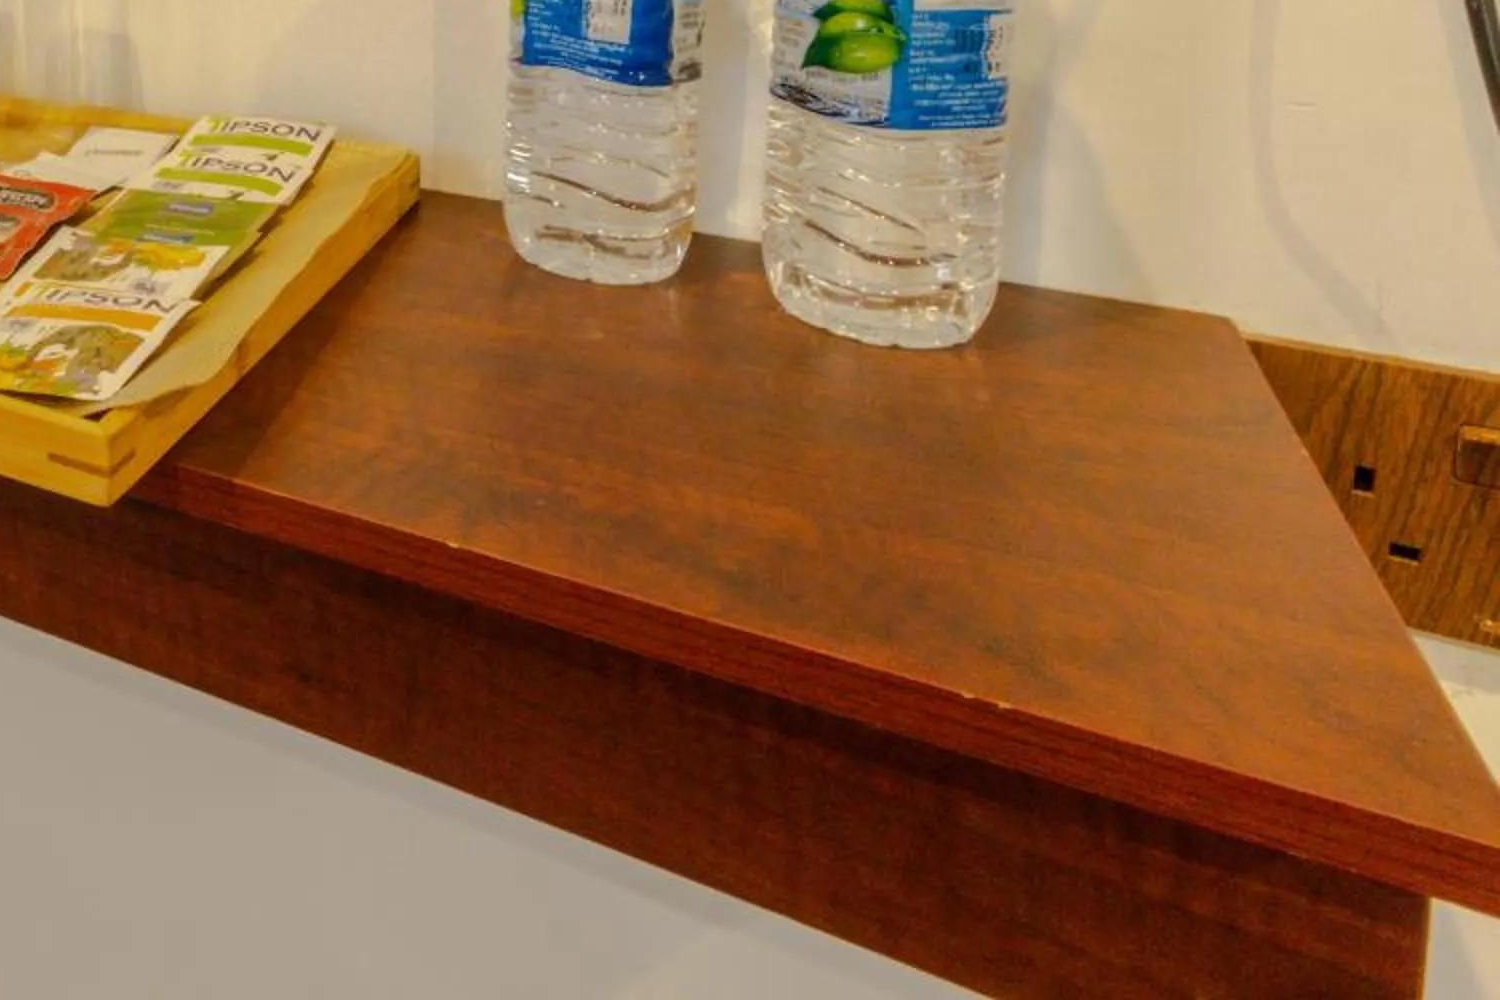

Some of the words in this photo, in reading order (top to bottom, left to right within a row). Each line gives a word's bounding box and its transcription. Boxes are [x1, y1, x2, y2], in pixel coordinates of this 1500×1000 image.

[208, 119, 321, 142] TIPSON
[180, 152, 296, 183] TIPSON
[35, 283, 178, 313] TIPSON
